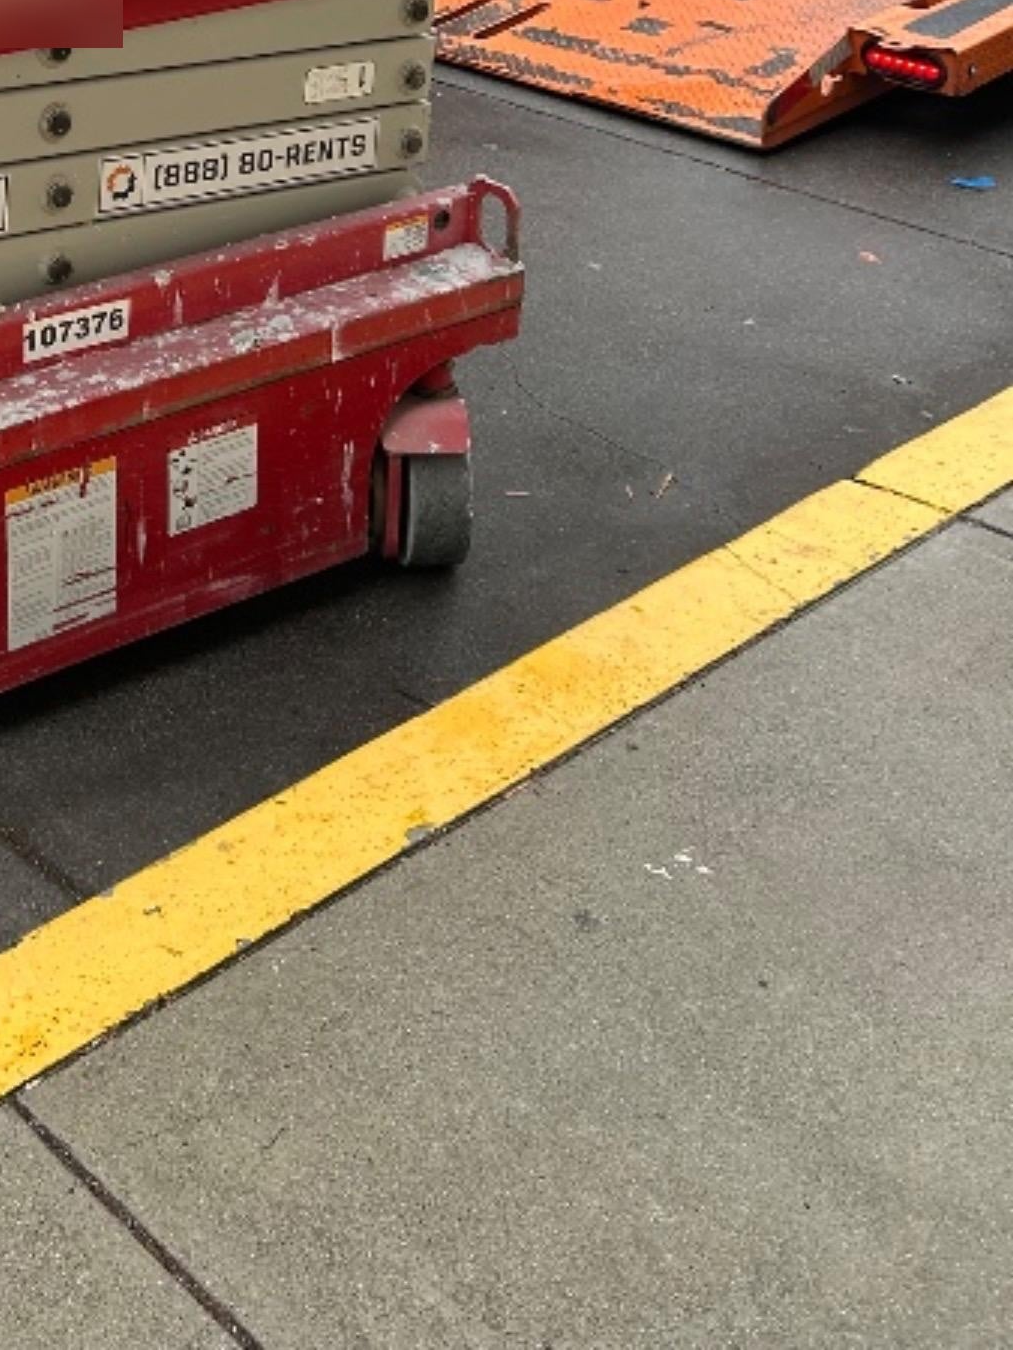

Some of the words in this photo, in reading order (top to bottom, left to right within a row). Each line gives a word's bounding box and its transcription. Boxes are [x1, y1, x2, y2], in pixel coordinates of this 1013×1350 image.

[154, 153, 229, 190] (888)
[238, 133, 368, 176] 80-RENTS
[25, 307, 125, 352] 107376
